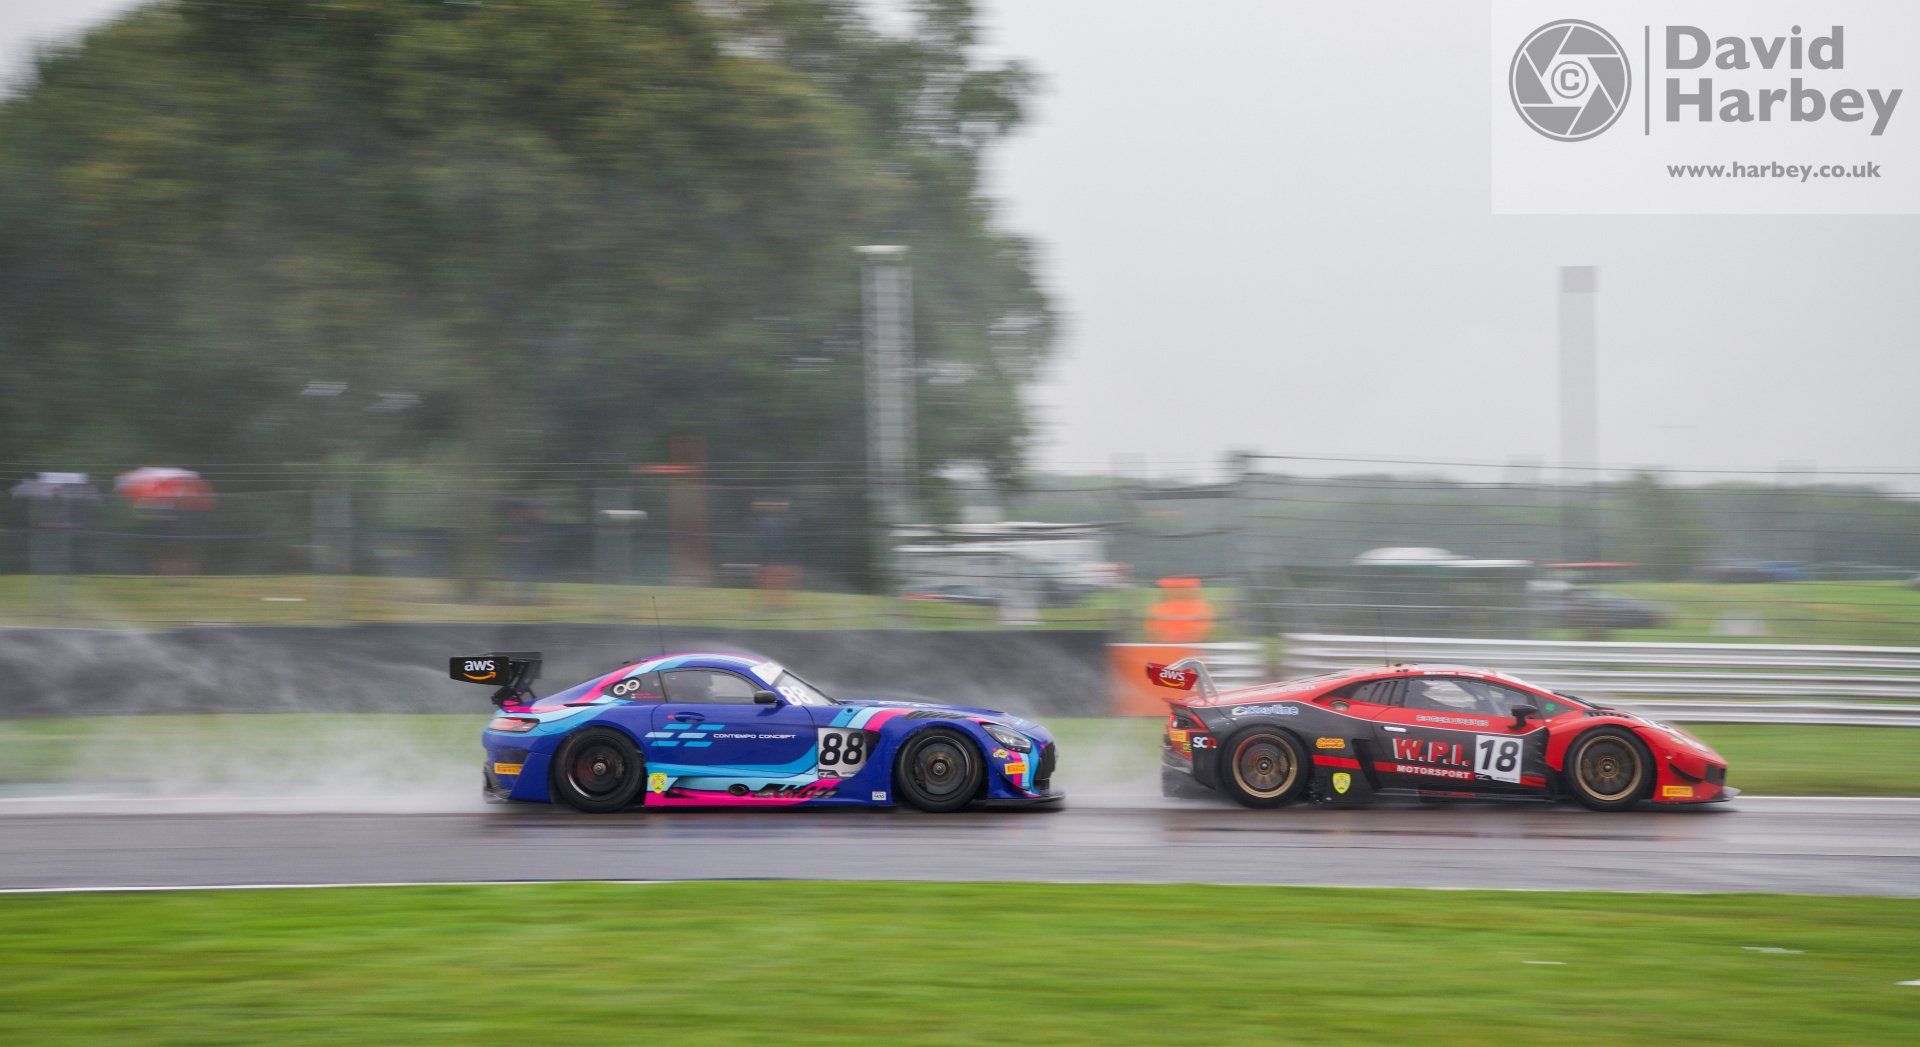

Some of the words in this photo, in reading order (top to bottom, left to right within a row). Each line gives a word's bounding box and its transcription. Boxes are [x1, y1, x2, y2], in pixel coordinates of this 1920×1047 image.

[464, 660, 495, 671] aws
[1159, 668, 1185, 681] aws
[820, 732, 865, 765] 88
[1393, 736, 1471, 767] W.P.I.
[1480, 739, 1519, 772] 18
[1397, 765, 1471, 779] MOTORSPORT
